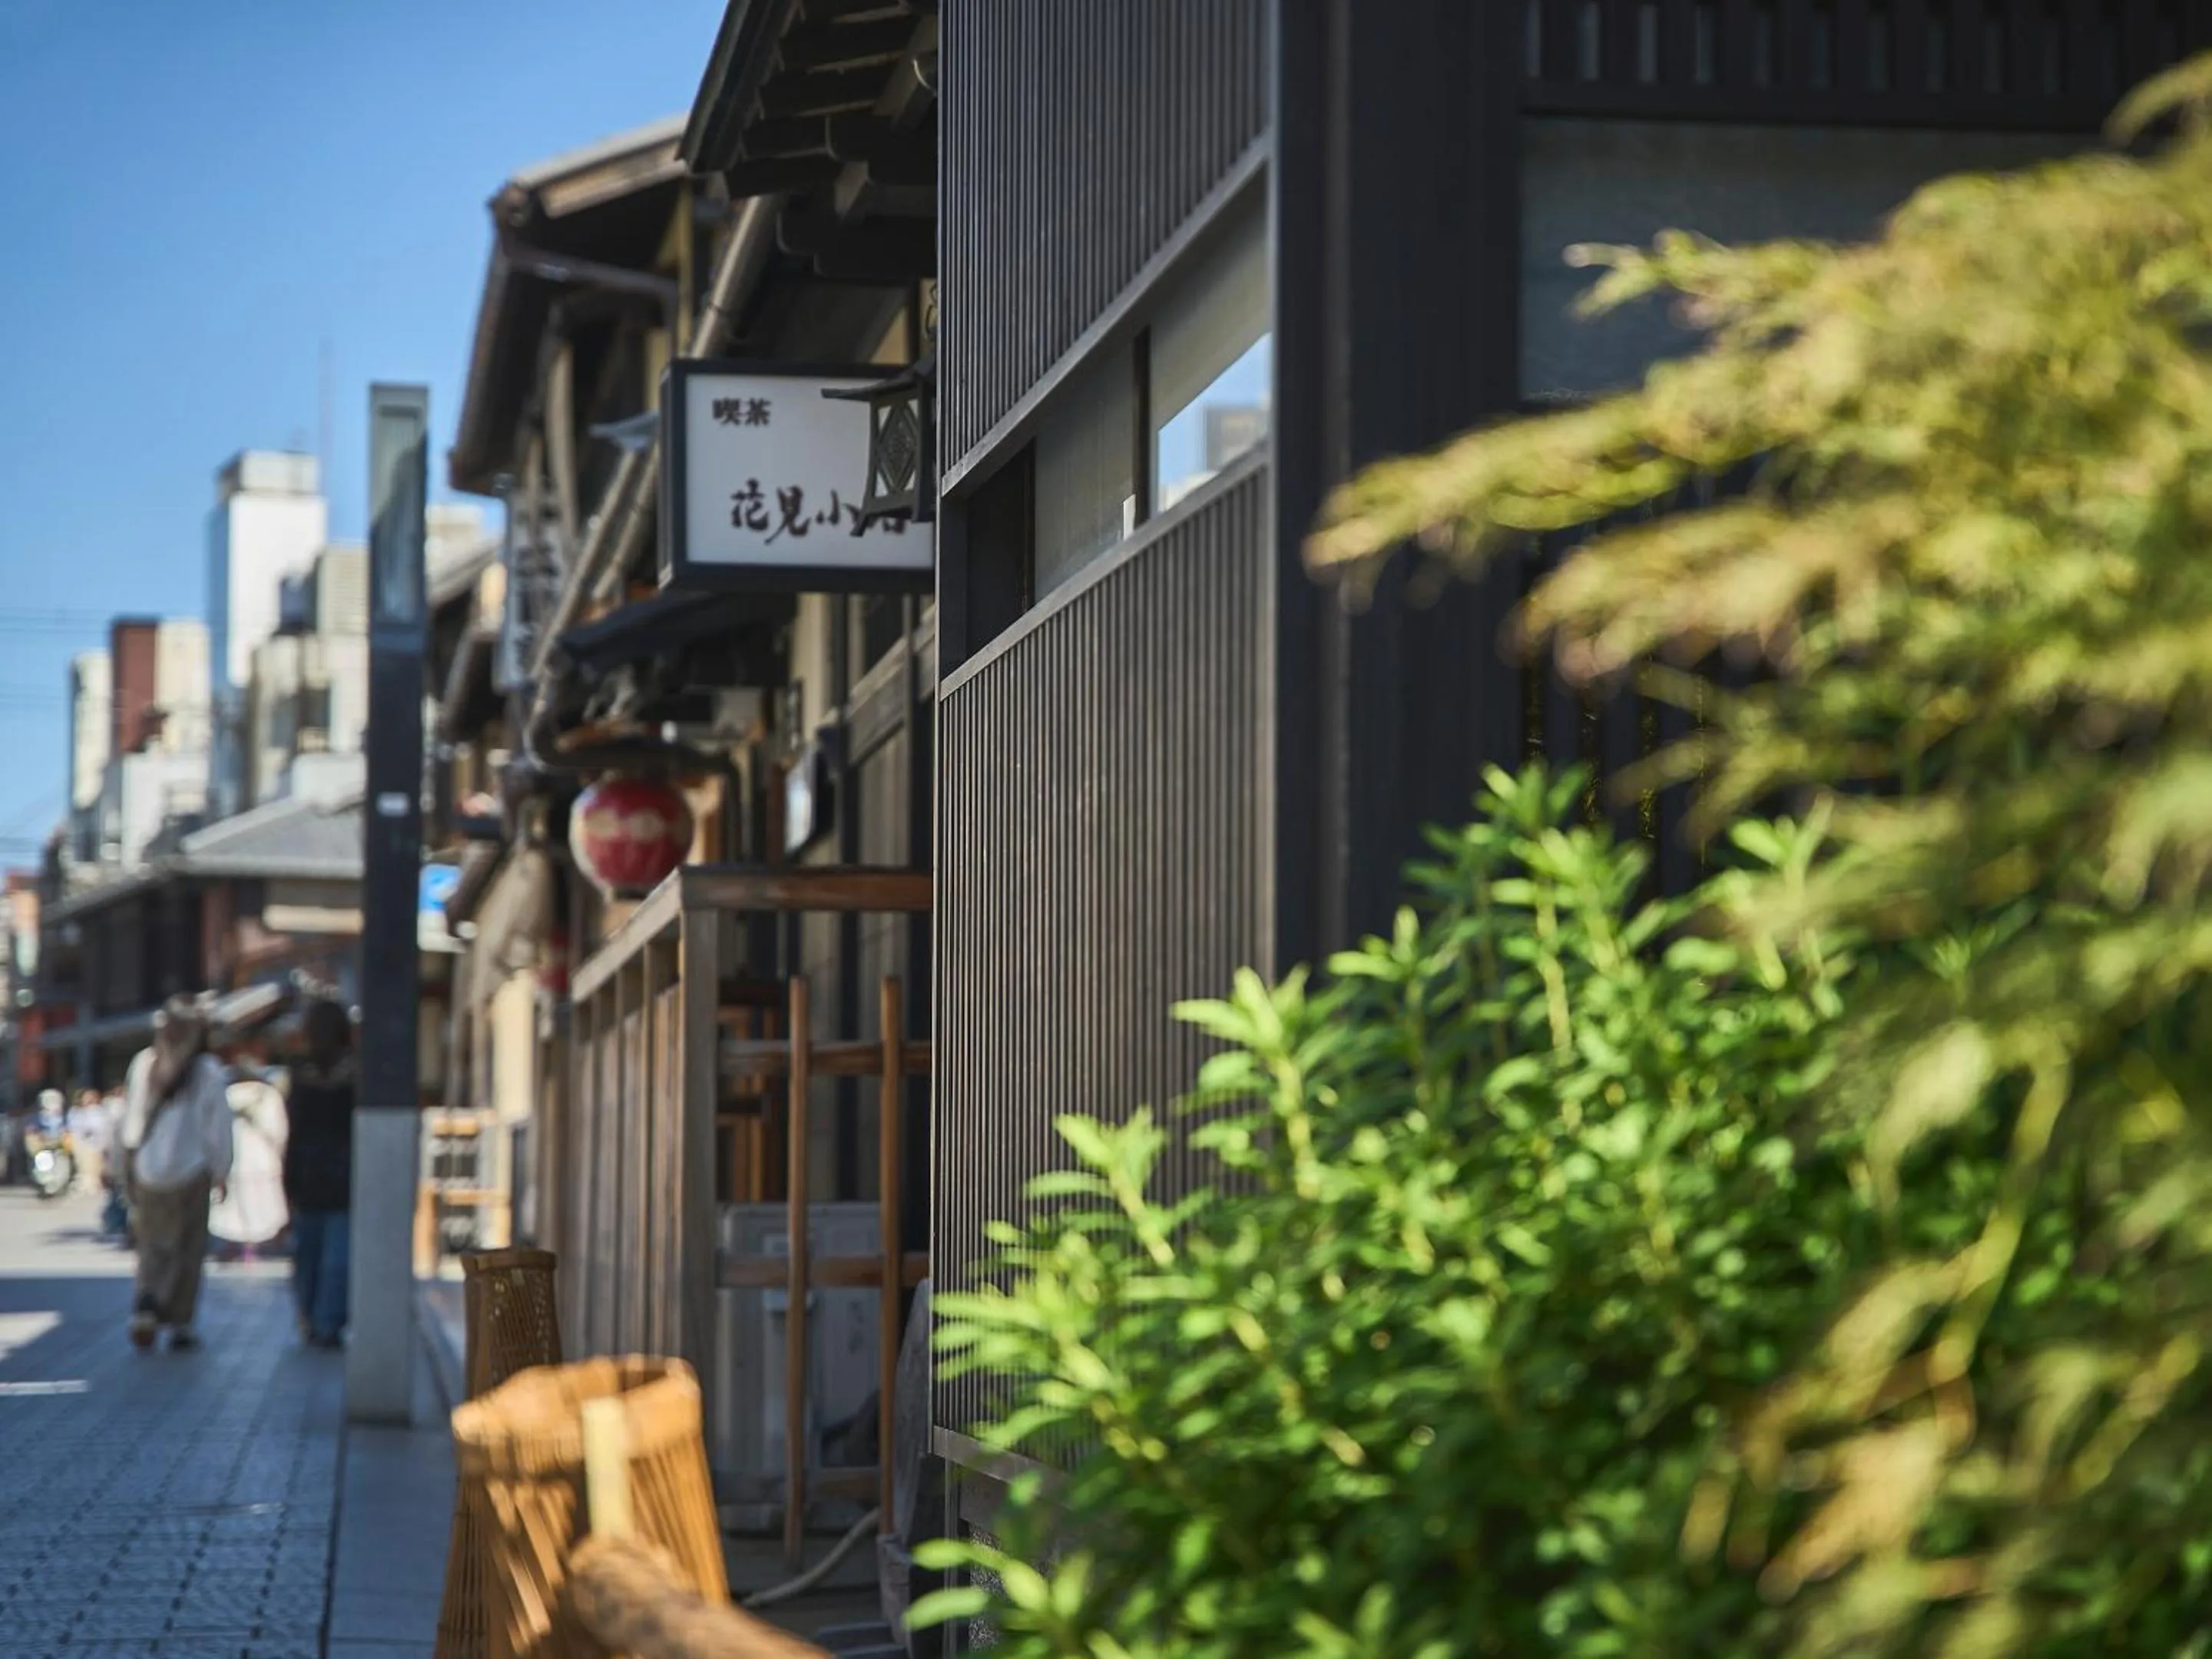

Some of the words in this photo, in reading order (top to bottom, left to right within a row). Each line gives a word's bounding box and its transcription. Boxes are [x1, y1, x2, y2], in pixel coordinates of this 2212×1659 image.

[712, 397, 771, 426] 喫茶
[730, 478, 906, 545] 花見小
